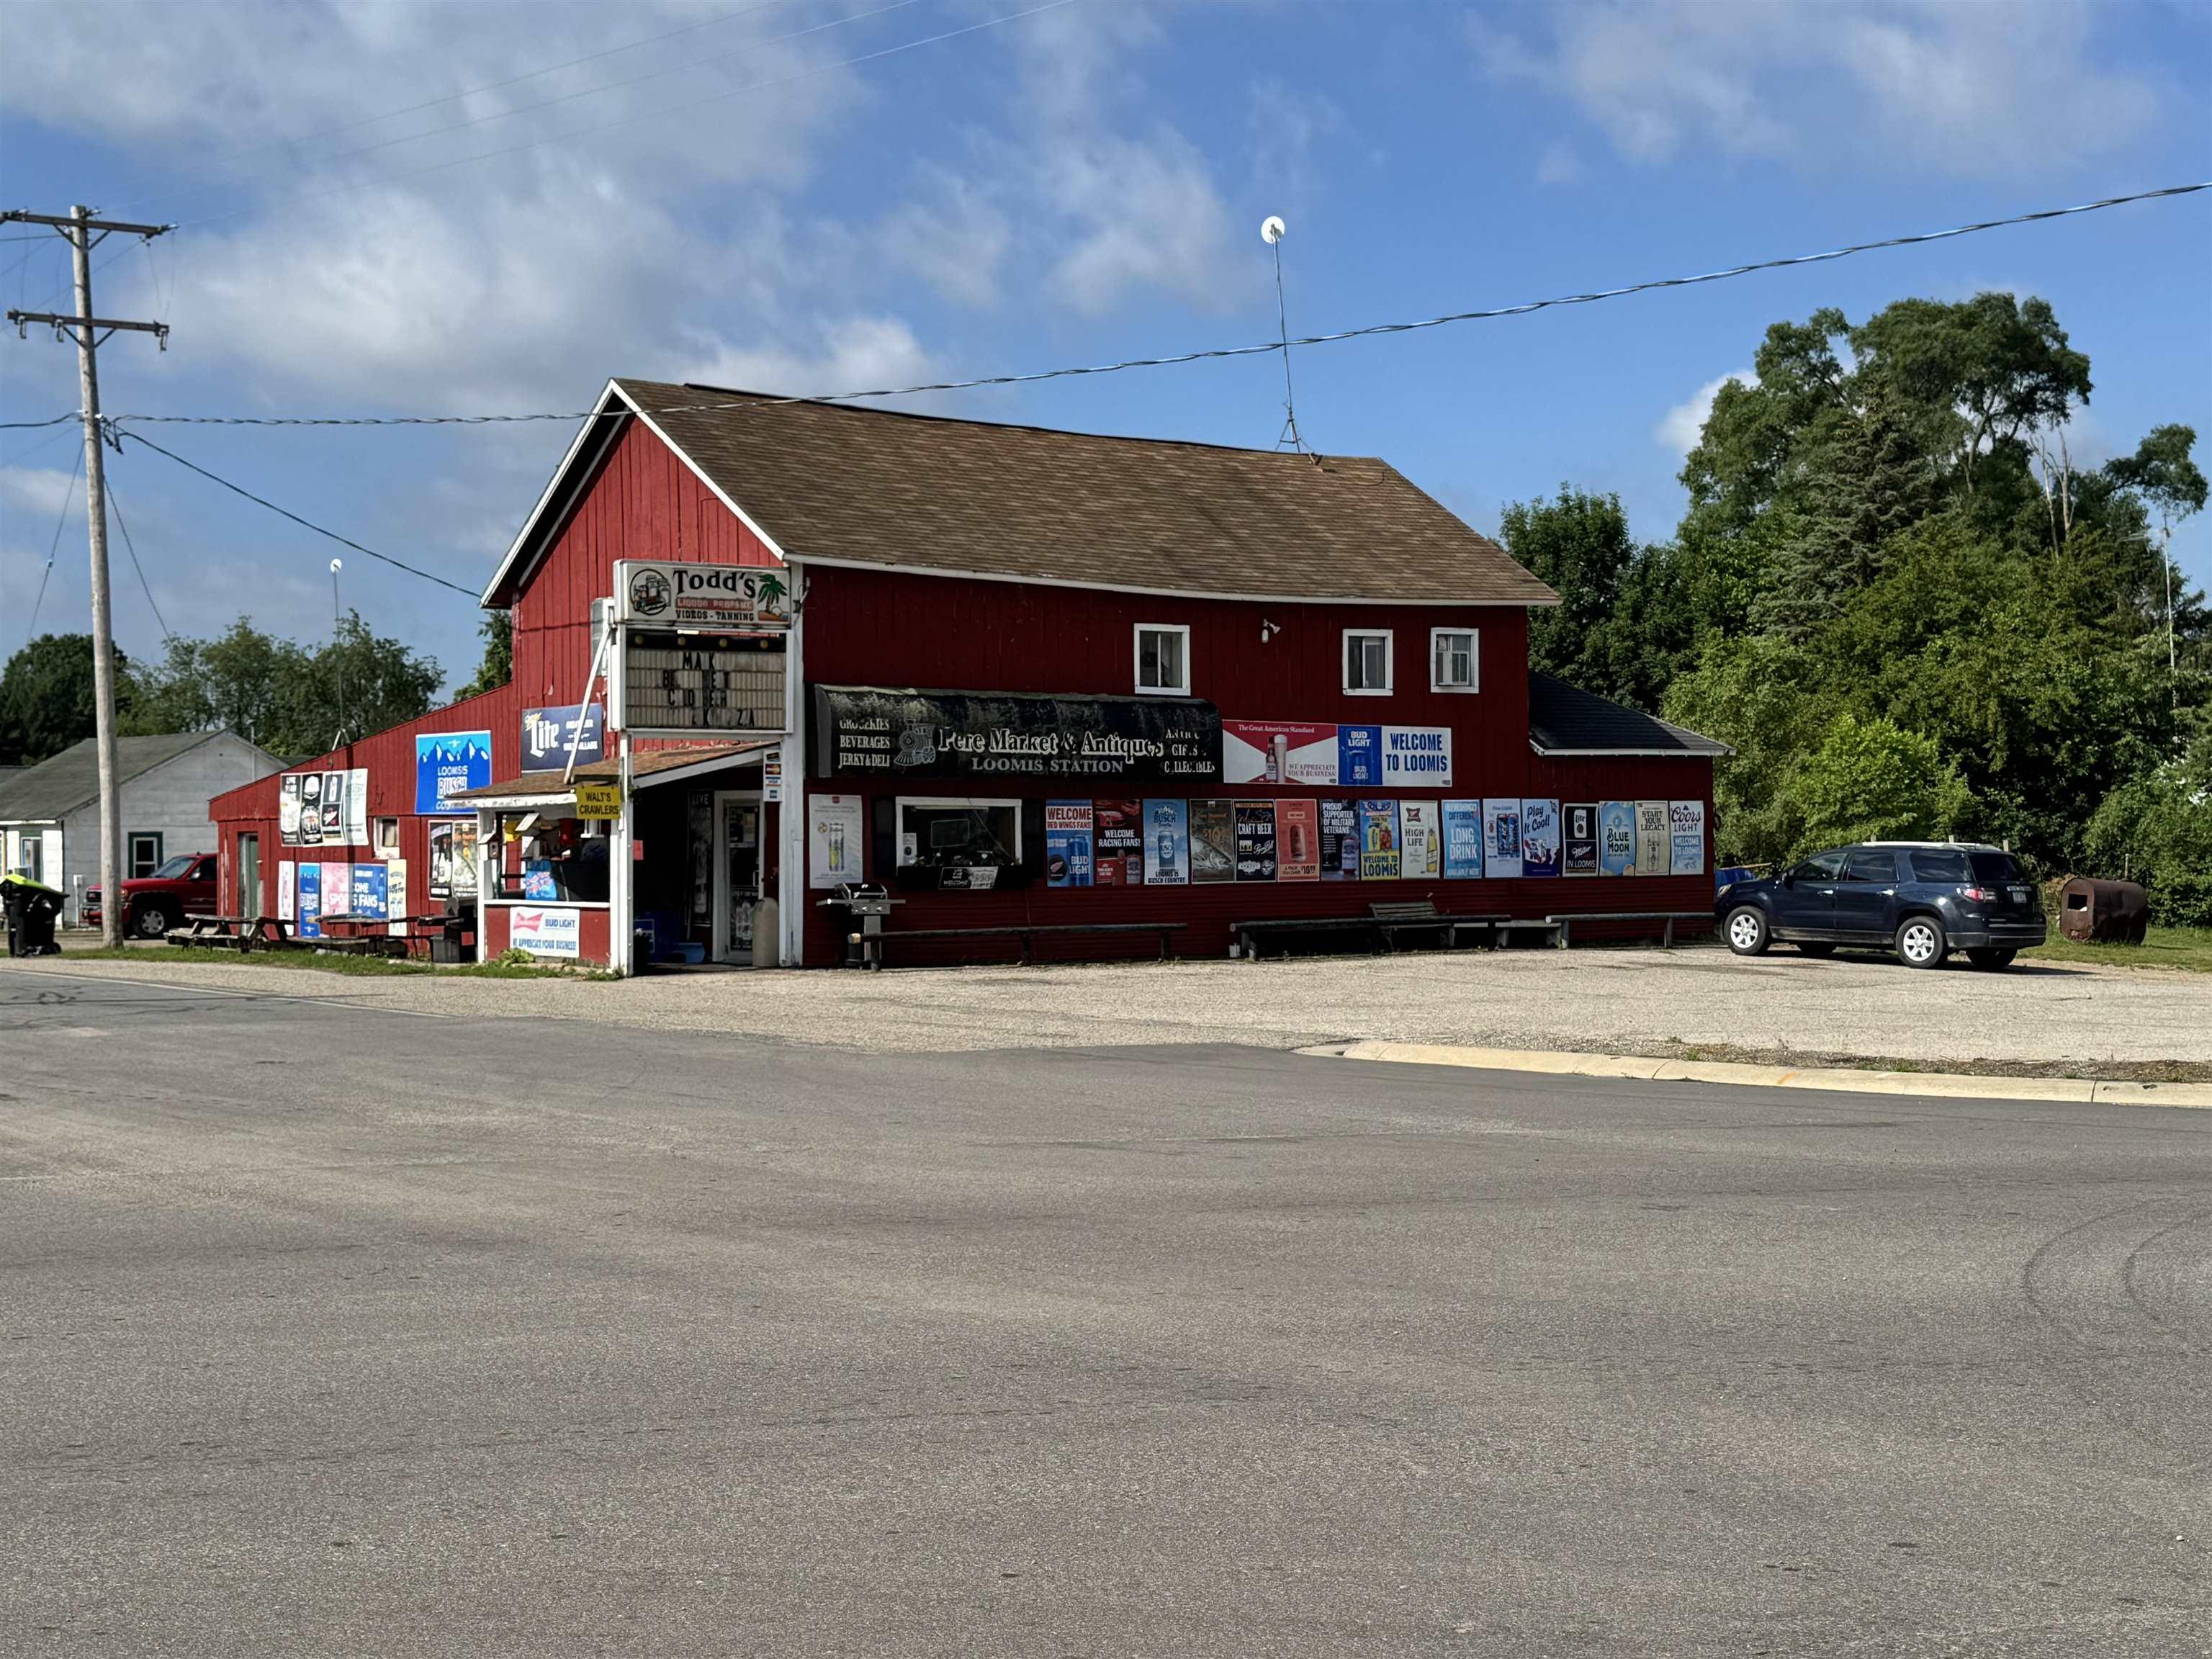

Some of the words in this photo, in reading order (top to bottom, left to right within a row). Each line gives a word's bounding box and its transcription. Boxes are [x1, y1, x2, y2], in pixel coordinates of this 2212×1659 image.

[673, 570, 755, 598] Todd's
[675, 610, 708, 620] VIDEOS
[716, 611, 754, 621] TANNING
[530, 719, 559, 758] Lite
[840, 735, 890, 749] BEVERAGES
[1348, 738, 1371, 747] LIGHT
[1390, 732, 1442, 750] WELCOME
[989, 727, 1059, 755] Market
[1061, 731, 1078, 755] &
[1080, 731, 1164, 765] Antiques
[1172, 744, 1198, 756] GIFS
[971, 758, 1043, 773] LOOMIS
[1050, 760, 1123, 773] STATION
[1385, 755, 1400, 772] TO
[1404, 755, 1447, 773] LOOMIS
[585, 792, 611, 801] WALT'S
[692, 794, 709, 805] LIVE
[579, 805, 619, 815] CRAWLERS
[1048, 808, 1092, 821] WELCOME
[1323, 810, 1354, 819] SUPPORTER
[1527, 806, 1544, 819] Play
[1671, 806, 1701, 822] Coors
[1331, 818, 1354, 827] MILITARY
[1532, 814, 1550, 831] Cool!
[1674, 824, 1698, 832] LIGHT
[1105, 830, 1135, 838] WELCOME
[1238, 823, 1256, 835] CRAFT
[1257, 823, 1272, 835] BEER
[1405, 828, 1424, 837] HIGH
[1451, 828, 1475, 844] LONG
[1606, 828, 1629, 842] BLUE
[1099, 838, 1122, 847] RACING
[1123, 838, 1141, 847] FANS!
[1407, 837, 1424, 846] LIFE
[1675, 837, 1700, 845] WELCOME
[1450, 844, 1477, 860] DRINK
[1607, 842, 1629, 853] MOON
[1071, 855, 1088, 865] BUD
[1575, 860, 1595, 868] LOOMIS
[1069, 865, 1089, 875] LIGHT
[1364, 863, 1398, 876] LOOMIS
[545, 918, 558, 927] BUD
[559, 918, 575, 928] LIGHT
